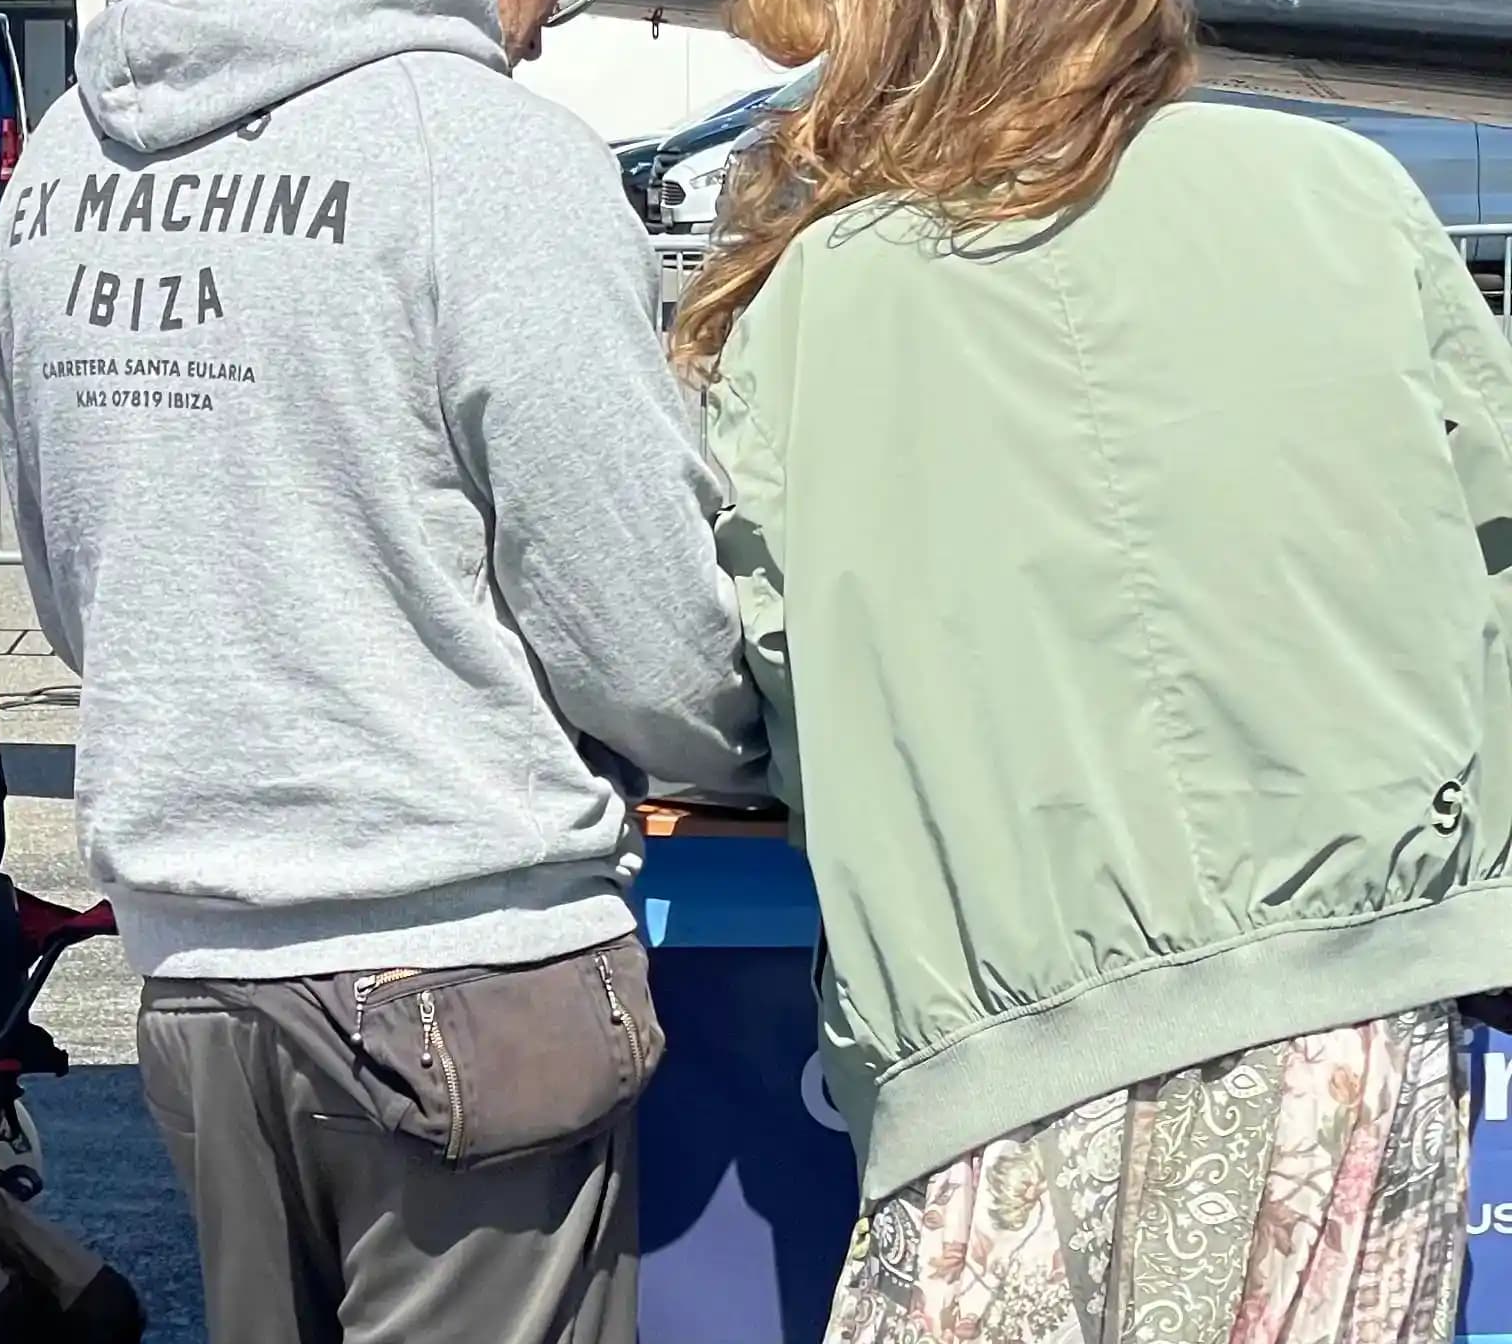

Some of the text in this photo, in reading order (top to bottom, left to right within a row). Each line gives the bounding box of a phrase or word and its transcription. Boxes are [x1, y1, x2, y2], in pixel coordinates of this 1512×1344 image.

[9, 173, 351, 248] EX MACHINA
[65, 263, 225, 332] IBIZA
[42, 358, 257, 384] CARRETERA SANTA EULARIA
[76, 390, 214, 411] KM2 07819 IBIZA
